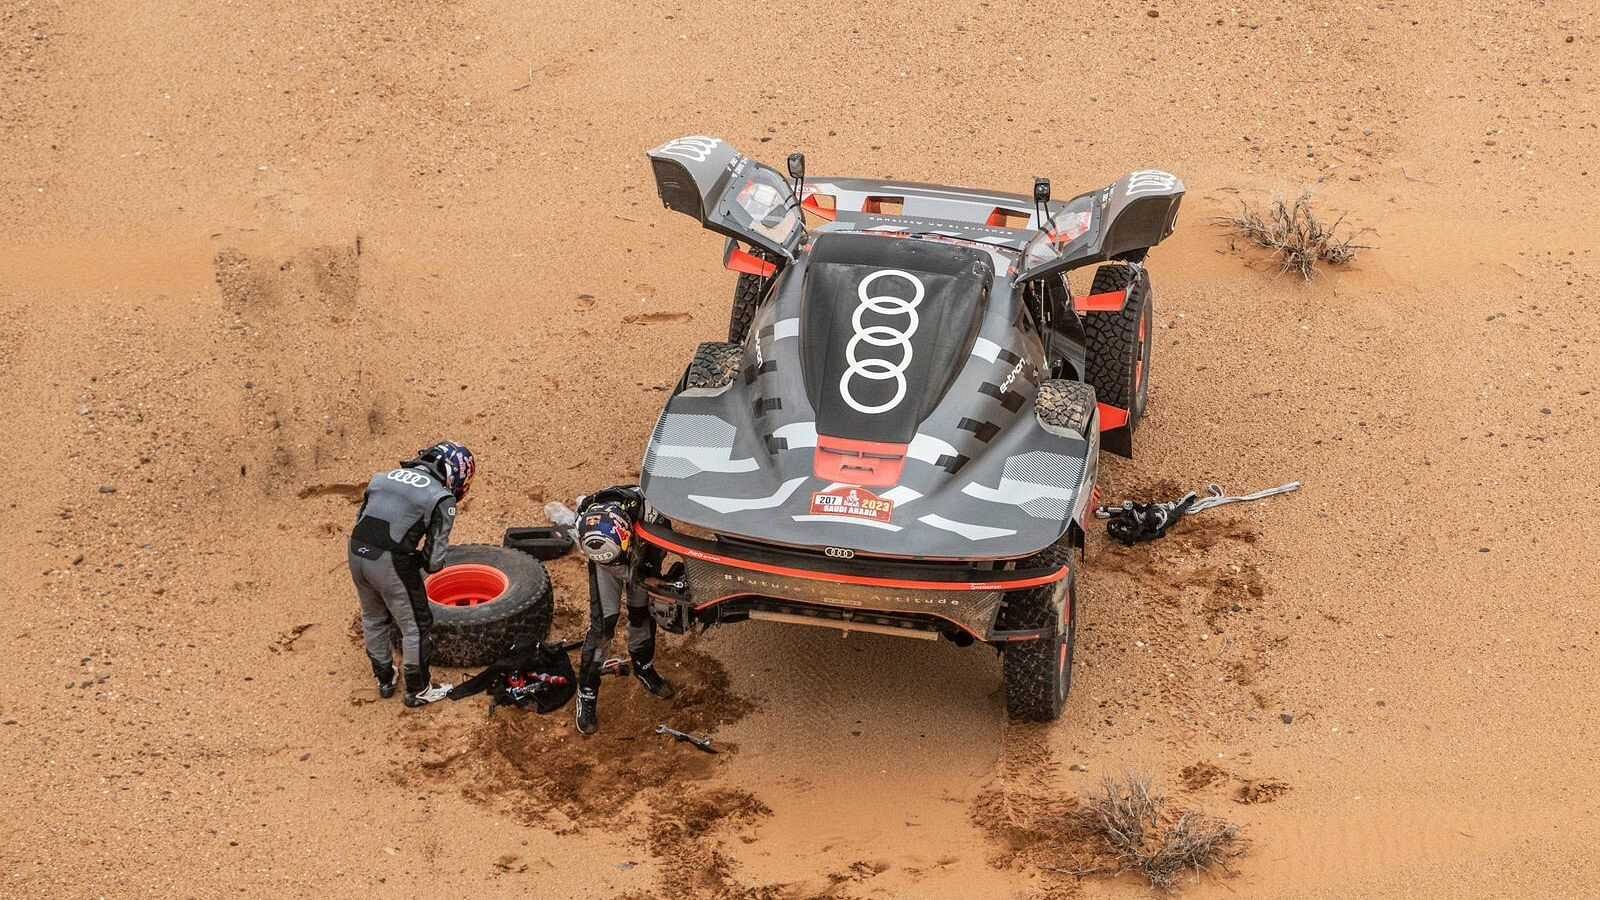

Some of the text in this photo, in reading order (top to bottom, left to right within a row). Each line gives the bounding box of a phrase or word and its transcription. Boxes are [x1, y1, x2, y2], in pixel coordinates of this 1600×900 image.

[1000, 358, 1025, 394] e-tron
[819, 496, 837, 504] 207
[862, 499, 889, 512] 2023
[823, 505, 877, 517] SAUDI ARABIA
